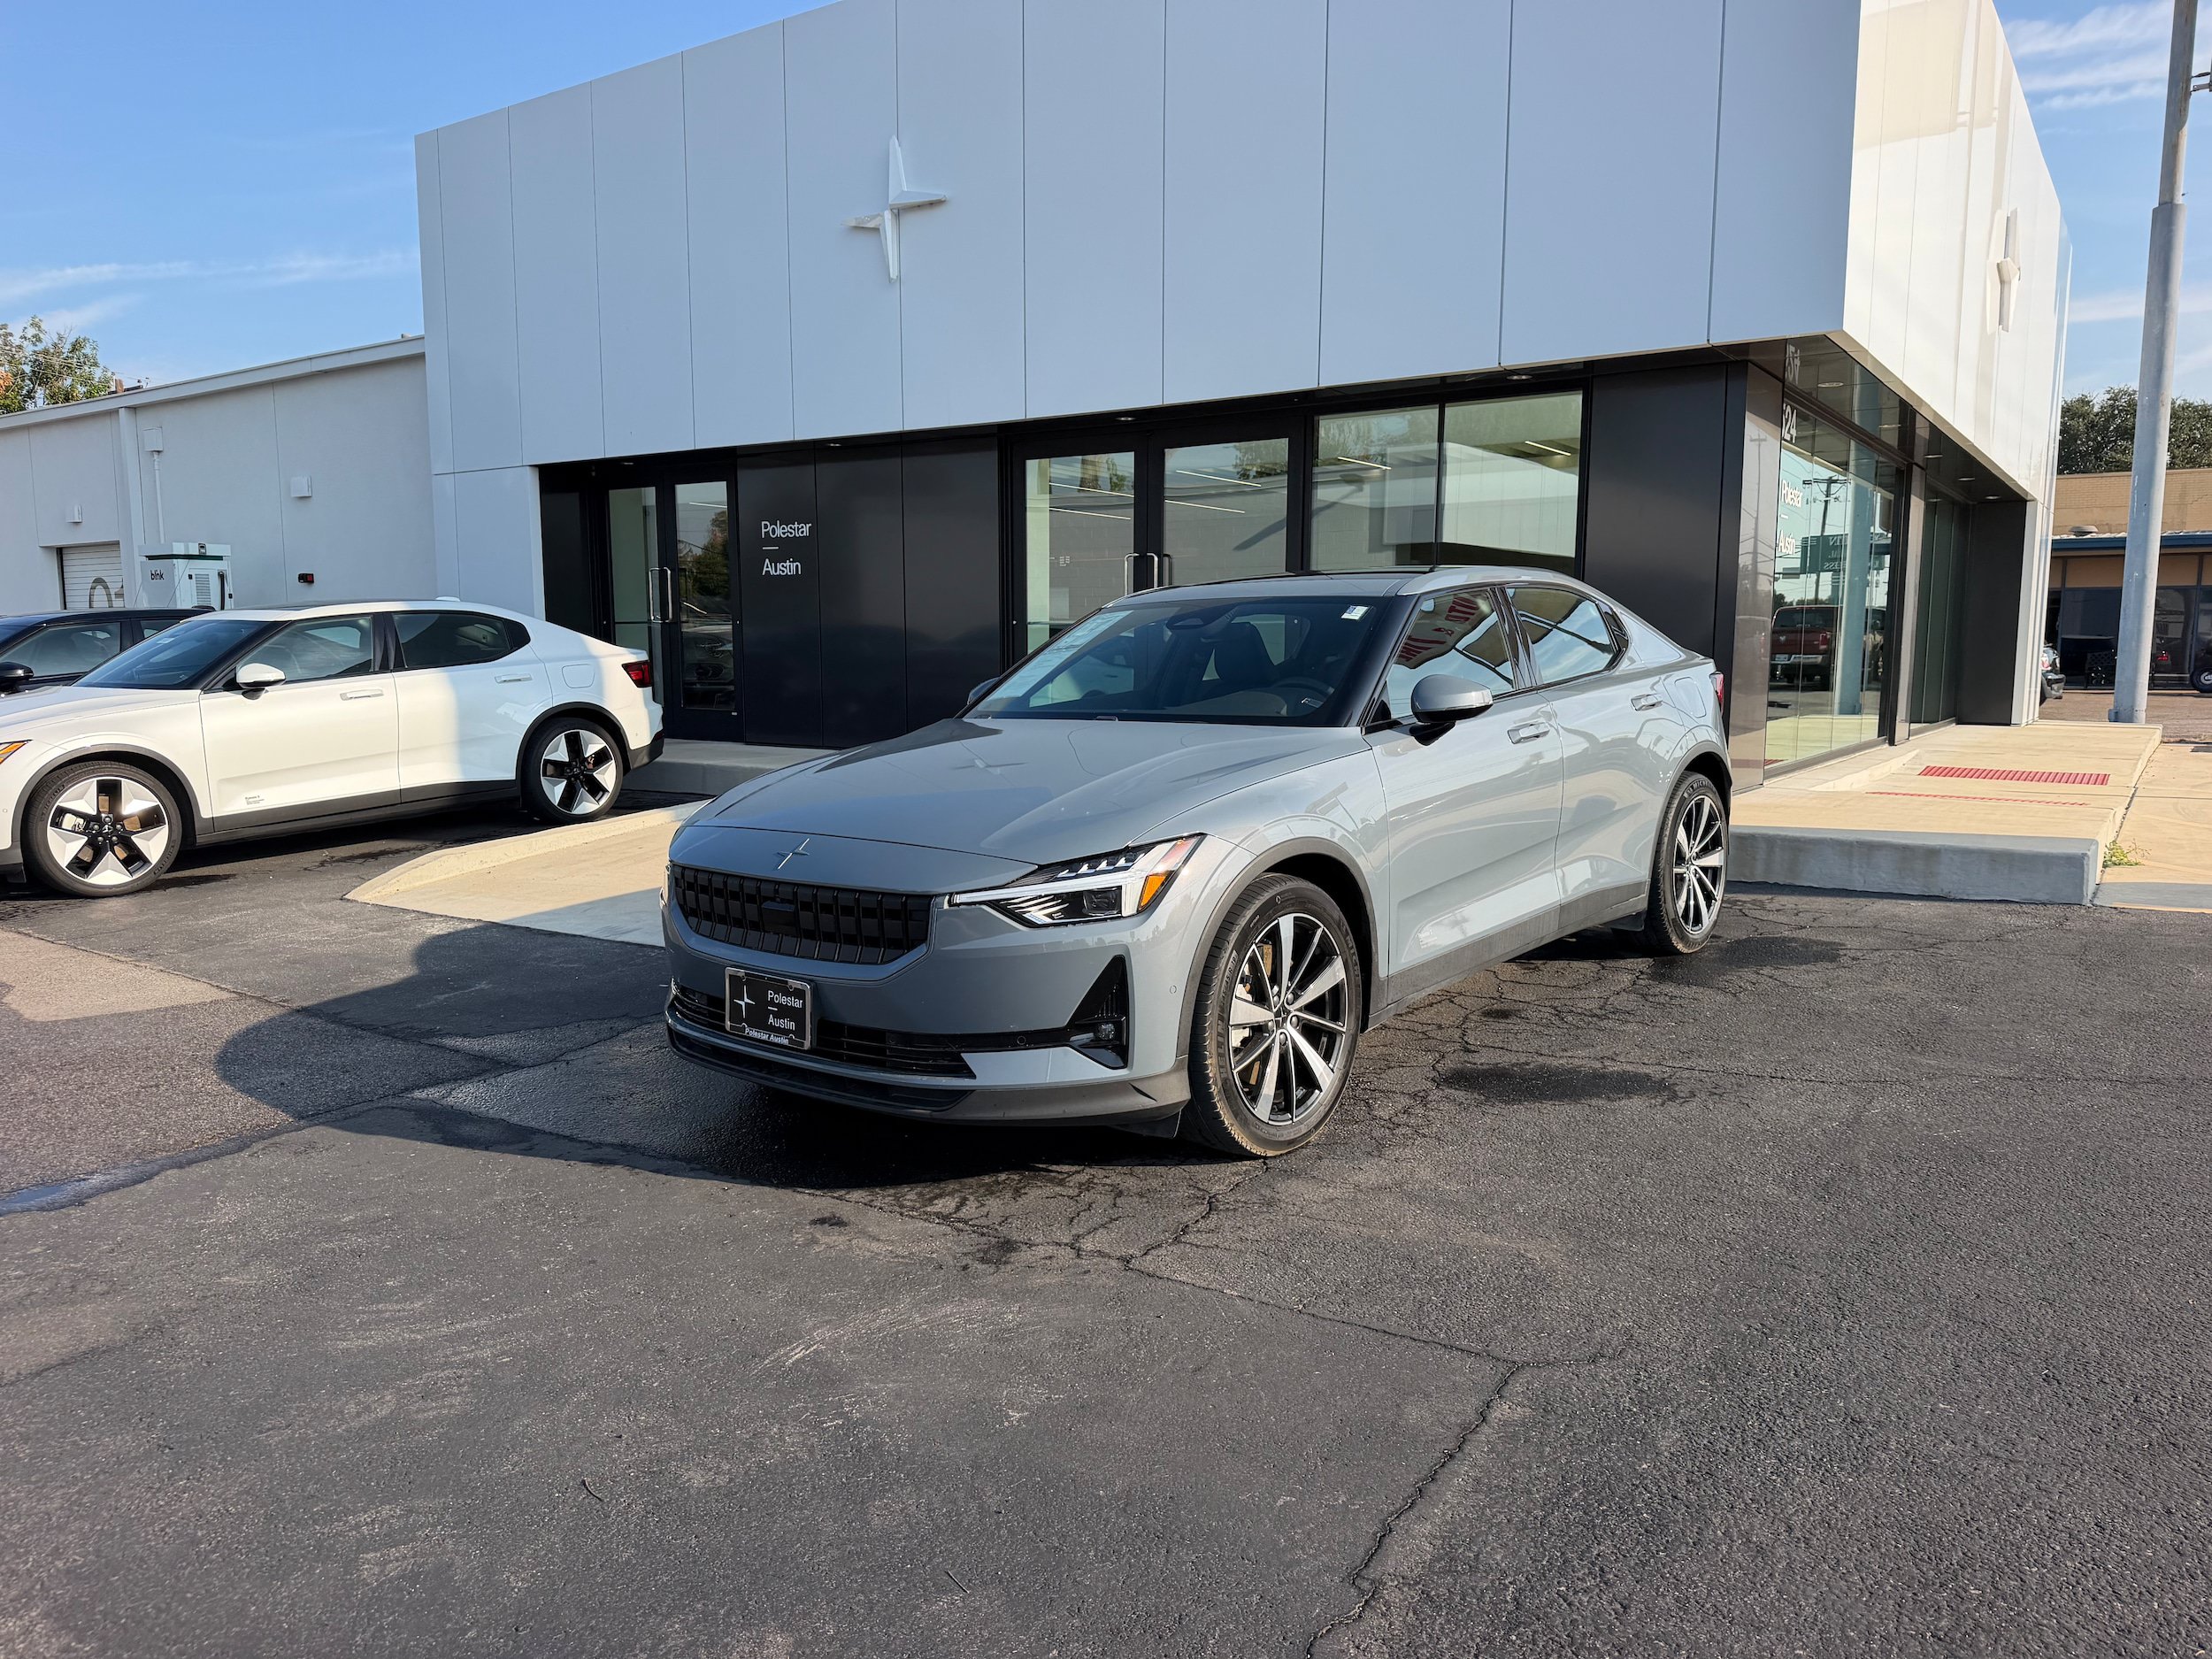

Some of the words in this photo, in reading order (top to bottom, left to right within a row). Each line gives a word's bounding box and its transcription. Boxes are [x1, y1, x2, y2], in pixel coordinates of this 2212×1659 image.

[761, 519, 811, 538] Polestar
[762, 558, 802, 575] Austin
[767, 990, 803, 1008] Polestar
[767, 1014, 795, 1031] Austin
[744, 1027, 769, 1040] Polestar
[769, 1033, 789, 1045] Austin
